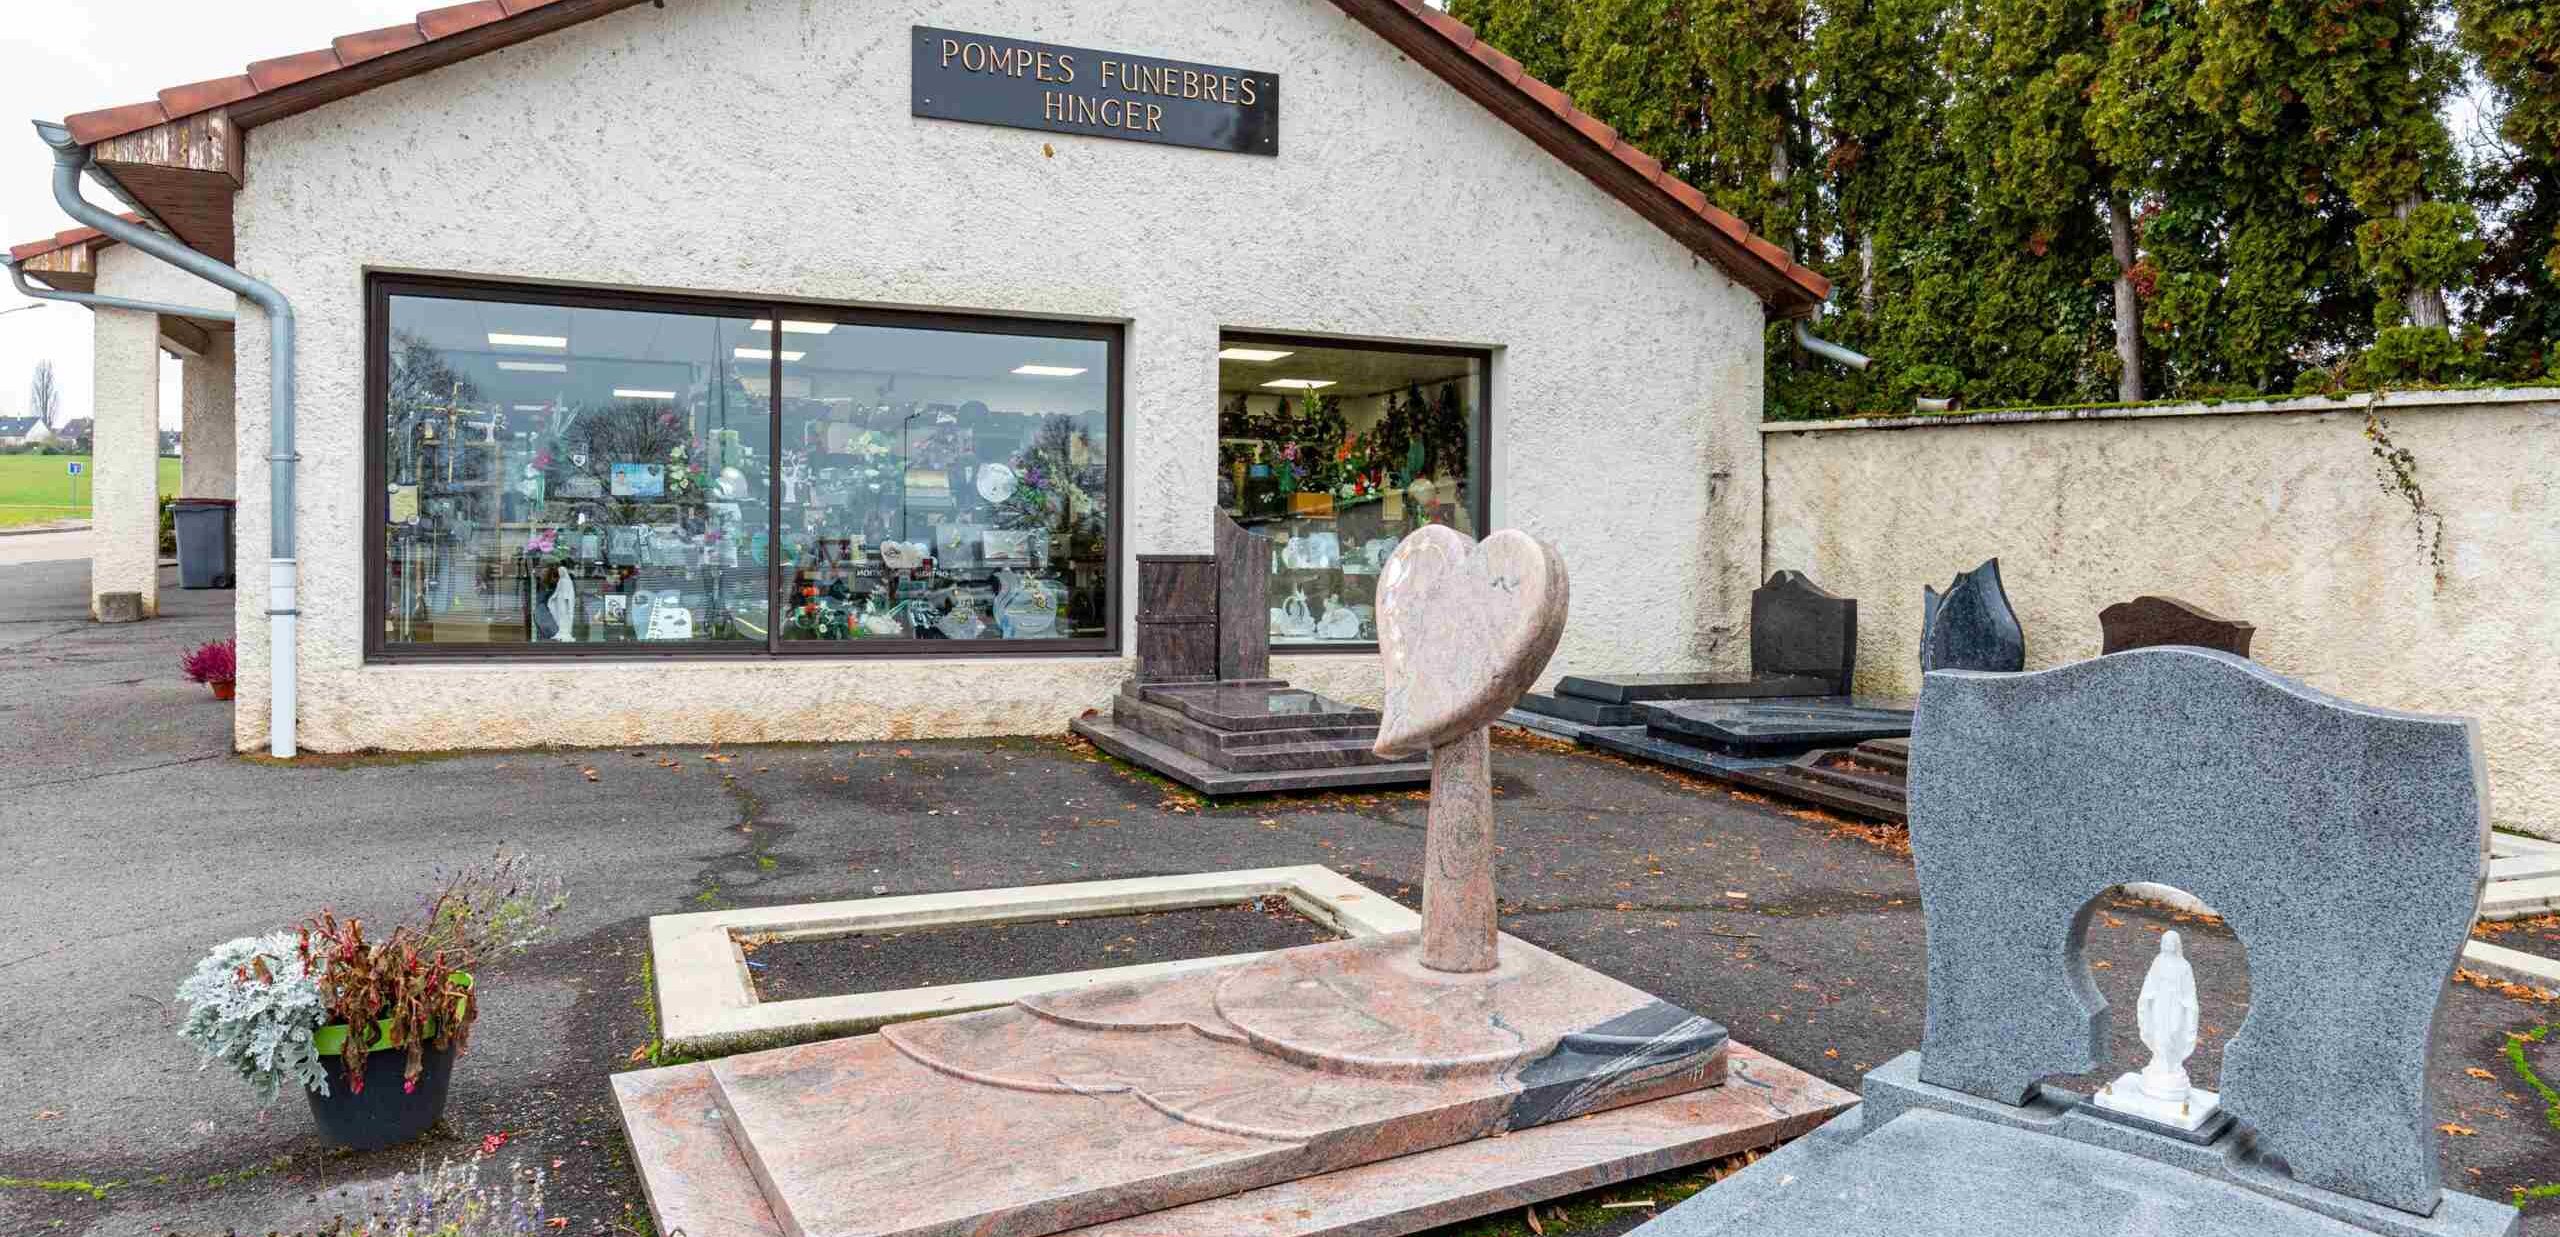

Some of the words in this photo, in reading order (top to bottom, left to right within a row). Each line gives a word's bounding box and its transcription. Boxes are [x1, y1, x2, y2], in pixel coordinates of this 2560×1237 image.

[940, 37, 1076, 84] POMPES
[1101, 60, 1257, 106] FUNEBRES
[1044, 91, 1163, 132] HINGER
